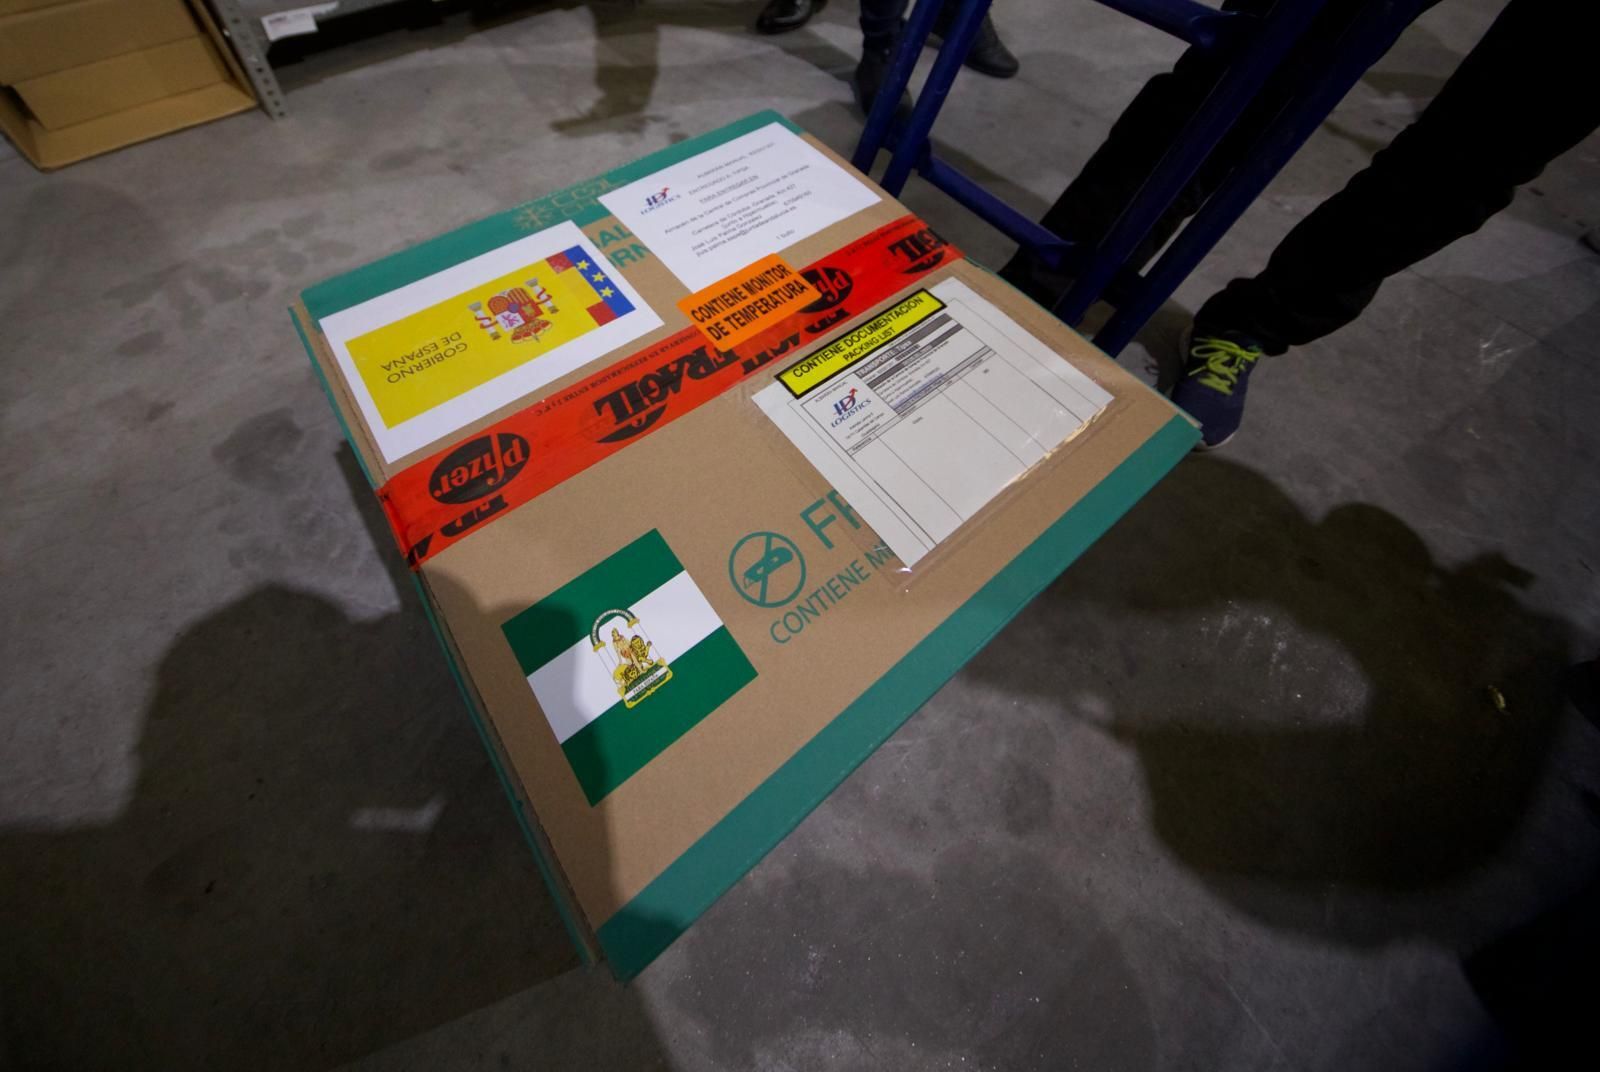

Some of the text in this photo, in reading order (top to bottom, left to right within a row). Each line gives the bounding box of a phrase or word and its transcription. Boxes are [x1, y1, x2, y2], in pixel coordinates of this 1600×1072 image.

[643, 188, 670, 205] ID
[731, 188, 756, 202] Compras
[690, 264, 791, 322] CONTIENE MONITOR
[707, 281, 808, 339] DE TEMPERATURA
[381, 332, 462, 372] DE ESPAÑA
[793, 347, 845, 377] CONTIENE
[843, 298, 923, 346] DOCUMENTACION
[843, 339, 880, 361] PACKING
[879, 328, 896, 340] LIST
[387, 343, 467, 383] GOBIERNO
[594, 345, 741, 424] FRAGIL
[832, 392, 857, 415] ID
[831, 400, 872, 427] LOGISTICS
[434, 433, 525, 497] Pfizer
[770, 560, 871, 644] CONTIENE
